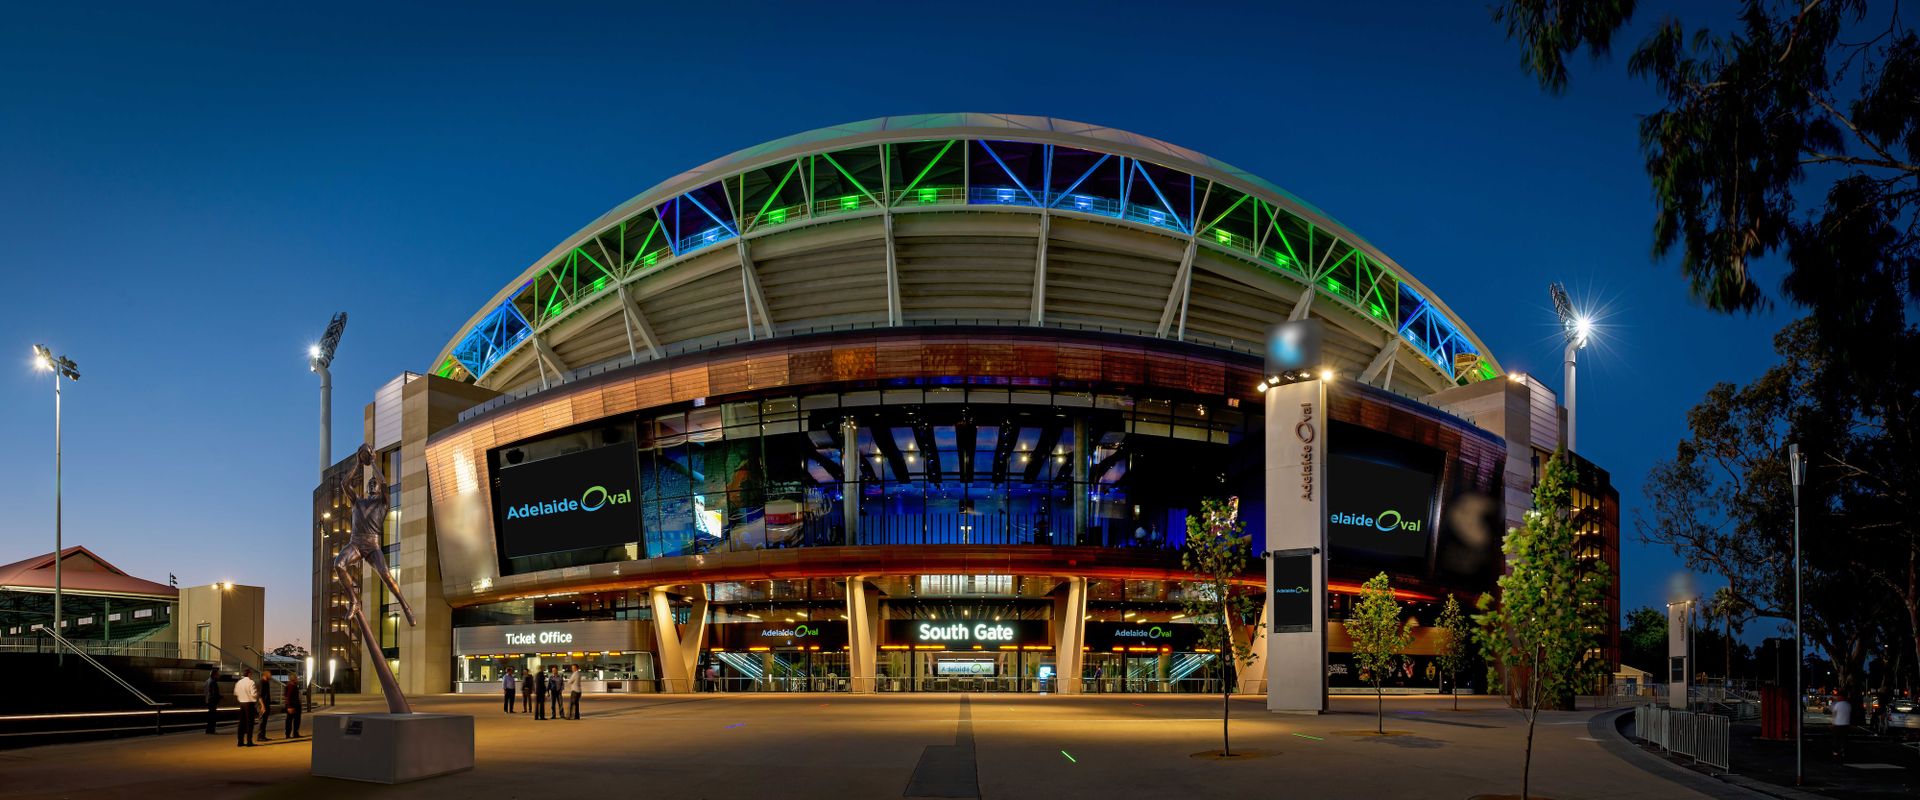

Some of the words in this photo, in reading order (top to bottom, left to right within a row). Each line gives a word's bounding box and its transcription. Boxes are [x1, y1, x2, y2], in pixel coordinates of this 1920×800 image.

[1295, 402, 1315, 444] Oval
[1301, 444, 1313, 502] Adelaide
[507, 498, 578, 520] Adelaide
[580, 485, 632, 512] Oval
[1330, 512, 1374, 527] elaide
[1375, 510, 1421, 532] Oval
[505, 632, 536, 645] Ticket
[539, 631, 573, 644] Office
[761, 629, 794, 637] Adelaide
[794, 624, 819, 638] Oval
[919, 623, 969, 640] South
[974, 623, 1014, 640] Gate
[1114, 629, 1148, 637] Adelaide
[1148, 626, 1172, 639] Oval
